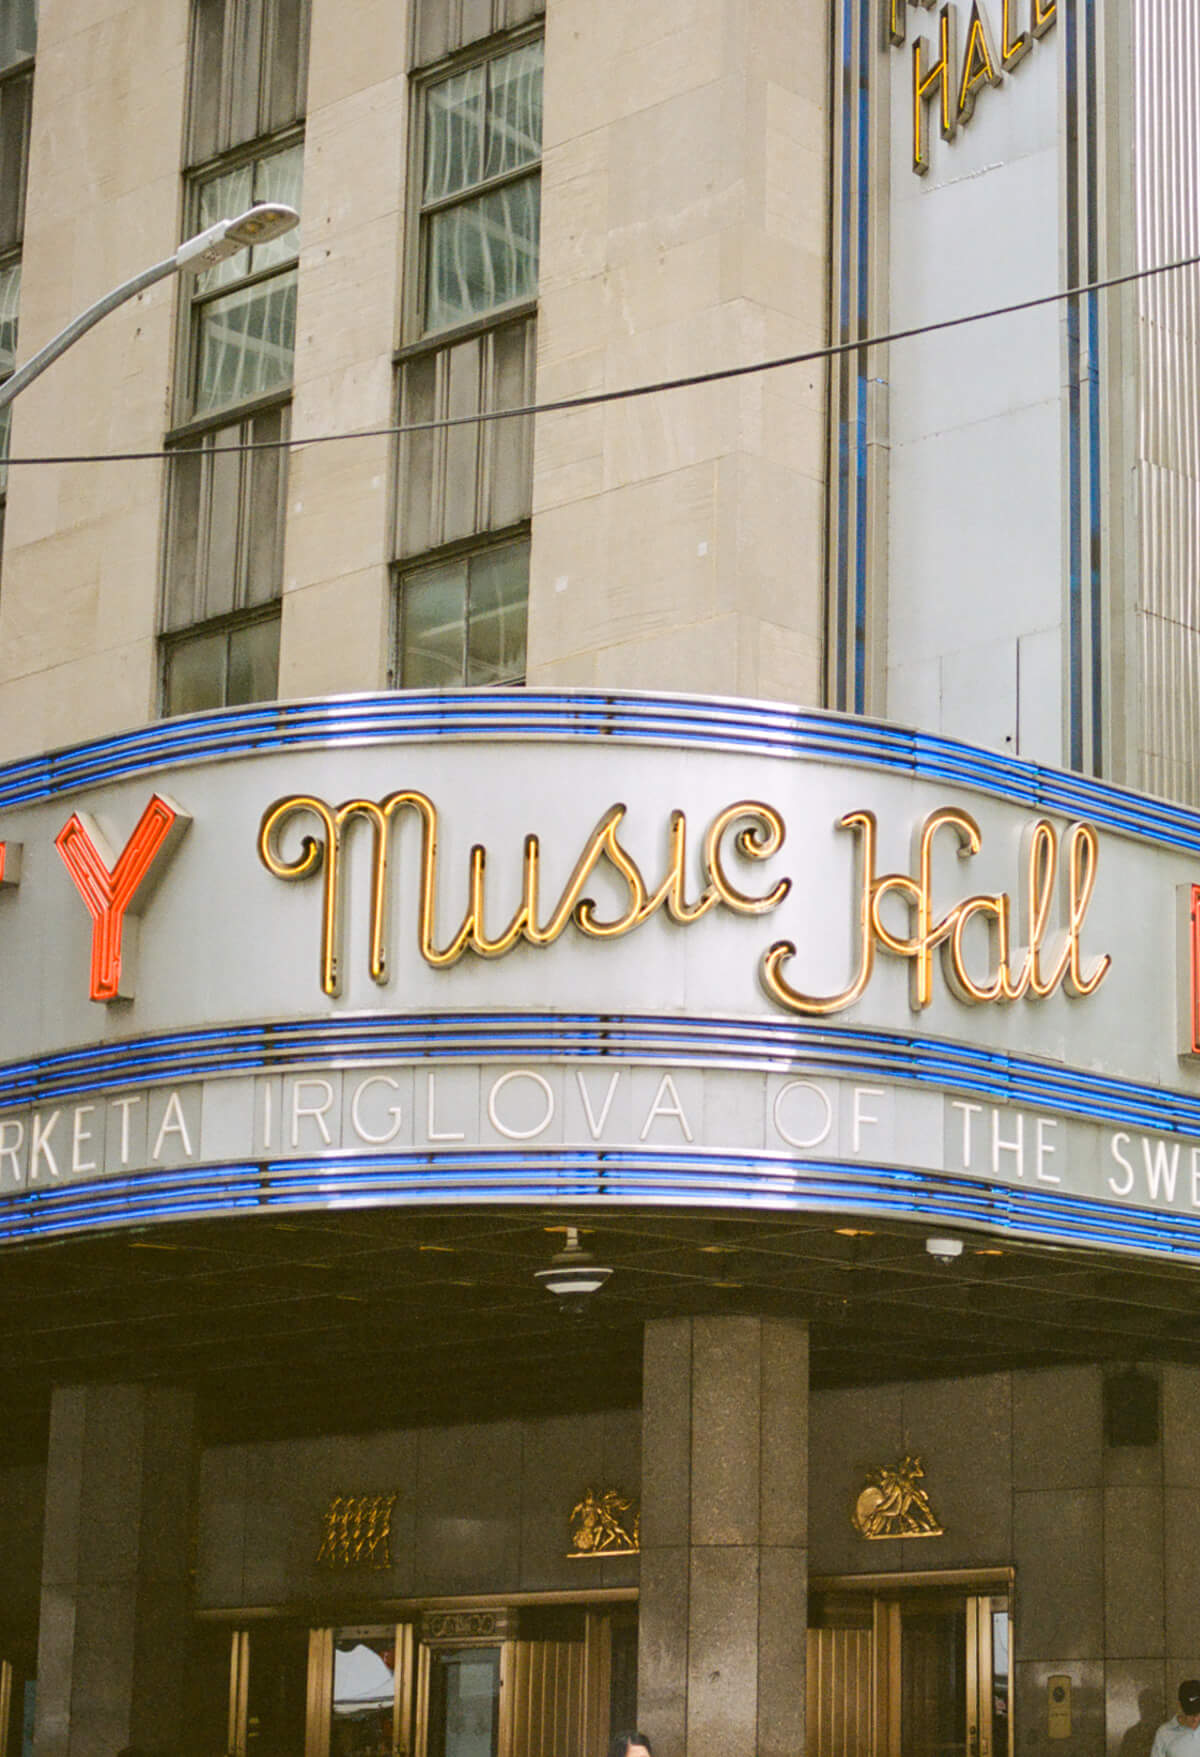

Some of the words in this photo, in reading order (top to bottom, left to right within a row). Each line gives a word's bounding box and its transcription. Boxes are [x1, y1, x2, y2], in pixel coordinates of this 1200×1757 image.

[0, 793, 193, 1001] Y
[258, 788, 792, 998] Music
[758, 806, 1112, 1016] Hall
[0, 1092, 192, 1181] RKETA
[262, 1070, 695, 1148] IRGLOVA
[773, 1080, 885, 1153] OF
[951, 1100, 1062, 1183] THE
